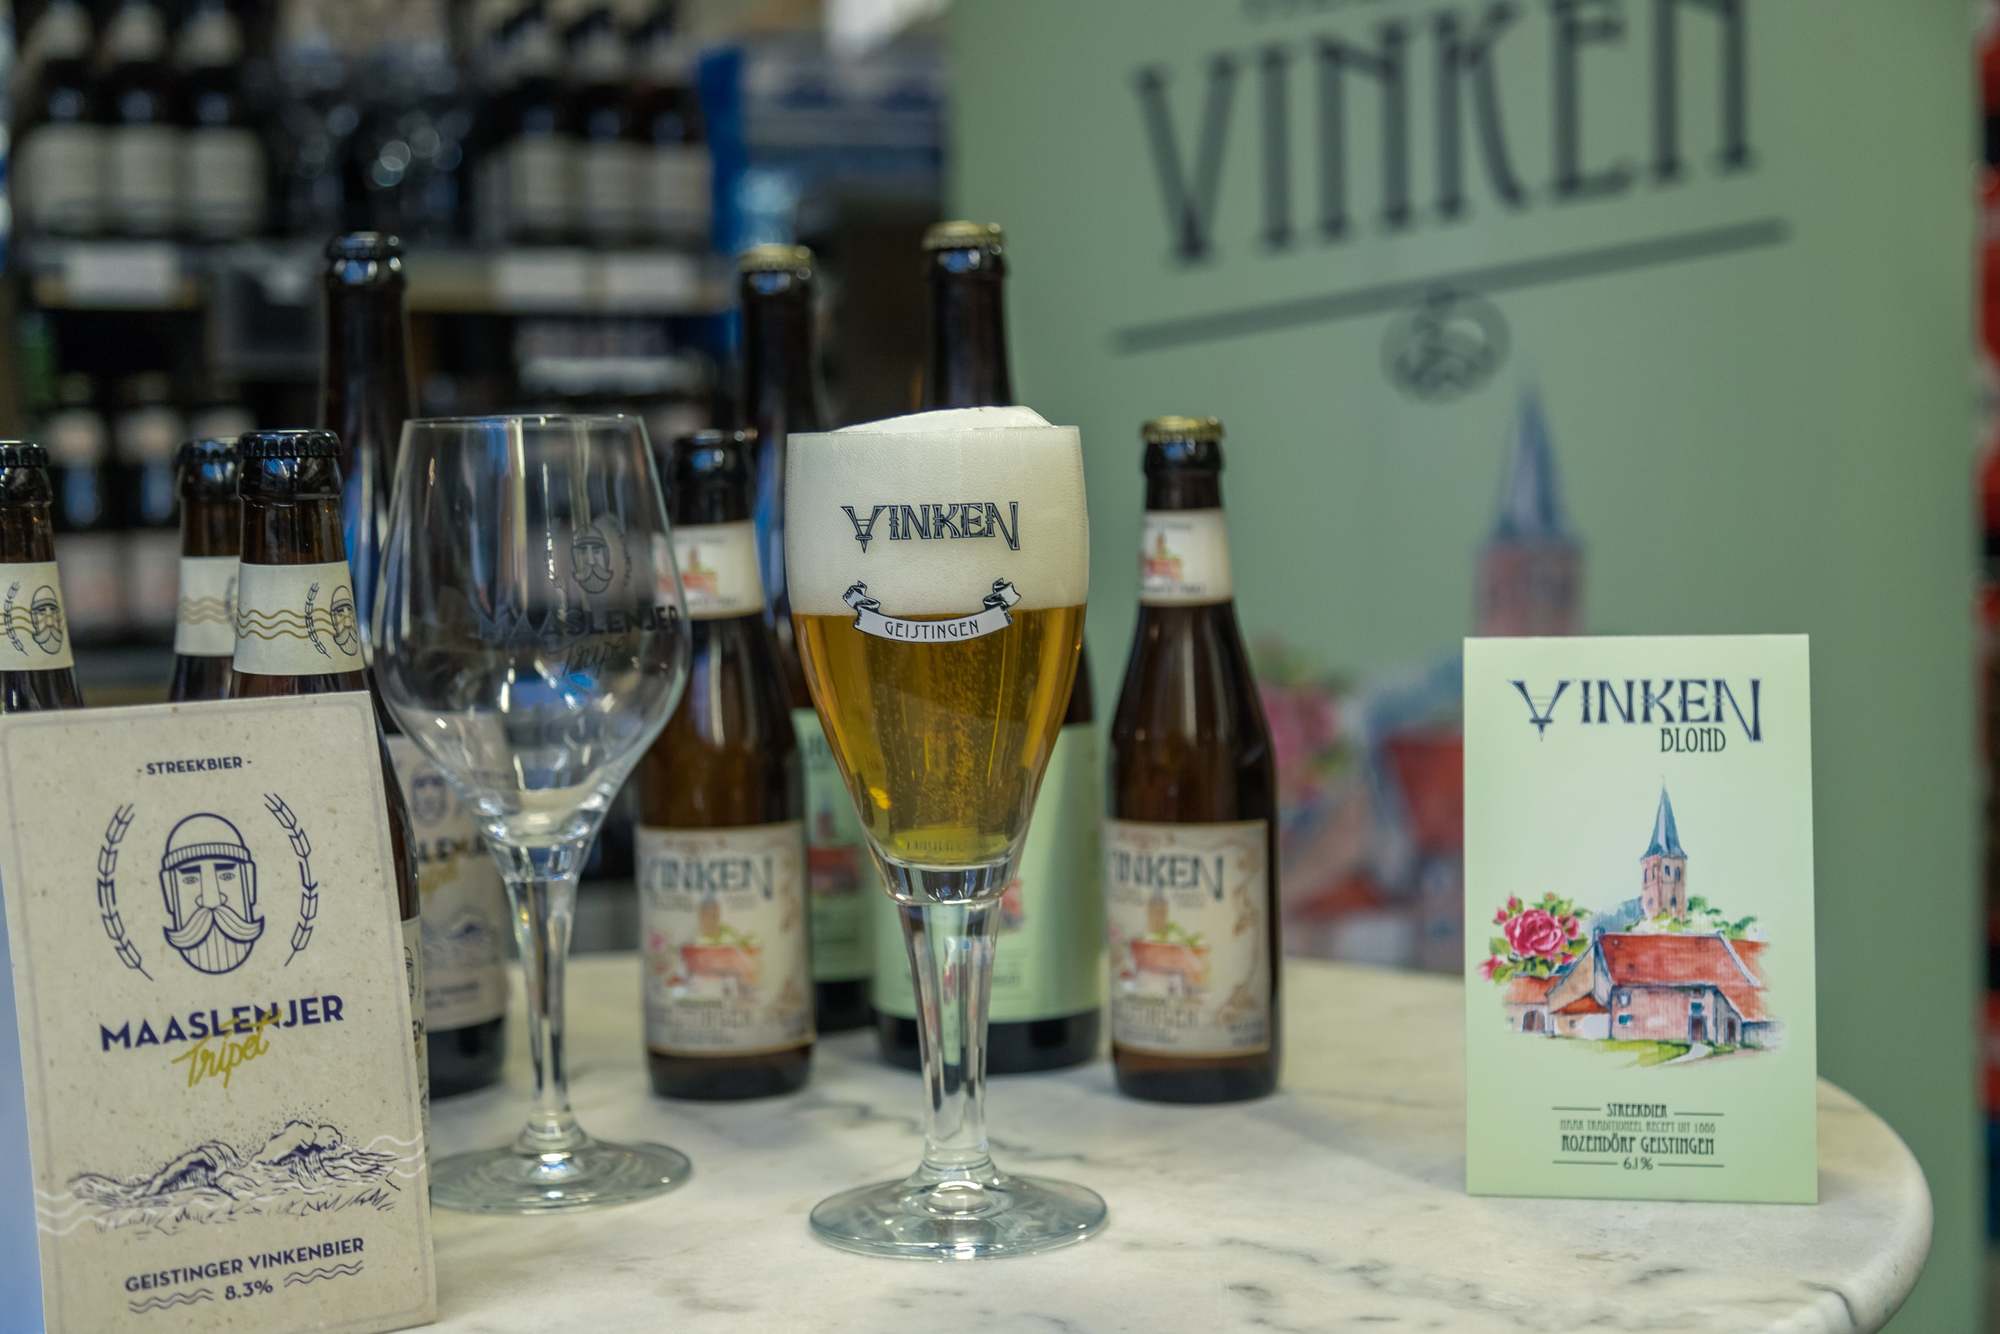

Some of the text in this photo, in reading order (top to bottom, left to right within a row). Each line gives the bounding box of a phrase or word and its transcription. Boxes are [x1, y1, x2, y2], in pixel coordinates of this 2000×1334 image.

[1128, 0, 1760, 266] VINKEN
[841, 501, 1021, 554] VINKEN
[884, 619, 979, 640] GEISTINGEN
[1507, 678, 1764, 742] VINKEN
[1660, 727, 1727, 753] BLOND
[146, 756, 243, 775] STREEKBIER
[99, 994, 344, 1052] MAASLENJER
[171, 1007, 283, 1088] Tripel
[1606, 1102, 1668, 1118] STREEKBIER
[1640, 1136, 1715, 1155] GEISTINGEN
[125, 1237, 364, 1293] GEISTINGER VINKENBIER
[224, 1280, 274, 1301] 8.3%
